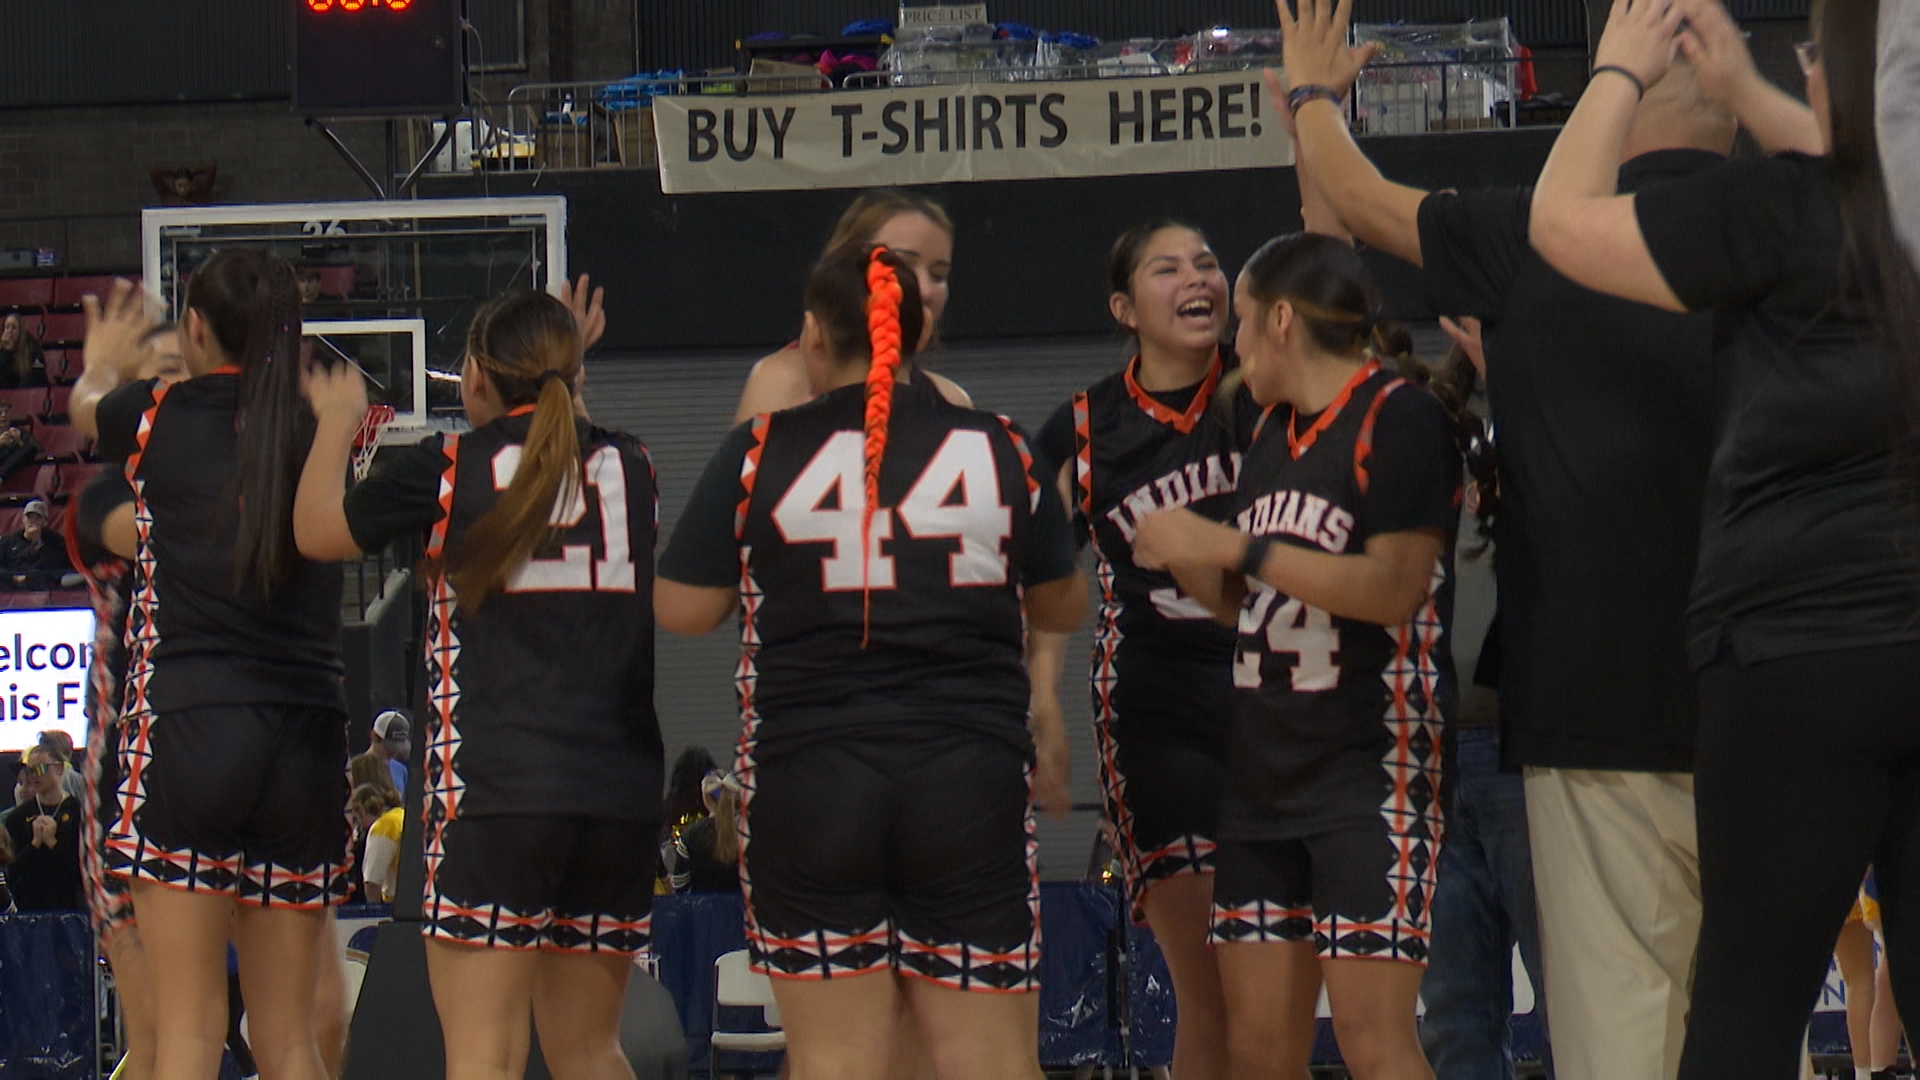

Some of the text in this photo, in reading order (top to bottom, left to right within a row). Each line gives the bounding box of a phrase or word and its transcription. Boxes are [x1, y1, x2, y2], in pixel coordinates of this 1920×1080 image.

[949, 6, 983, 21] LIST
[688, 82, 1263, 163] BUY T-SHIRTS HERE!
[490, 444, 637, 594] 21
[770, 429, 1012, 592] 44
[1232, 576, 1341, 692] 24
